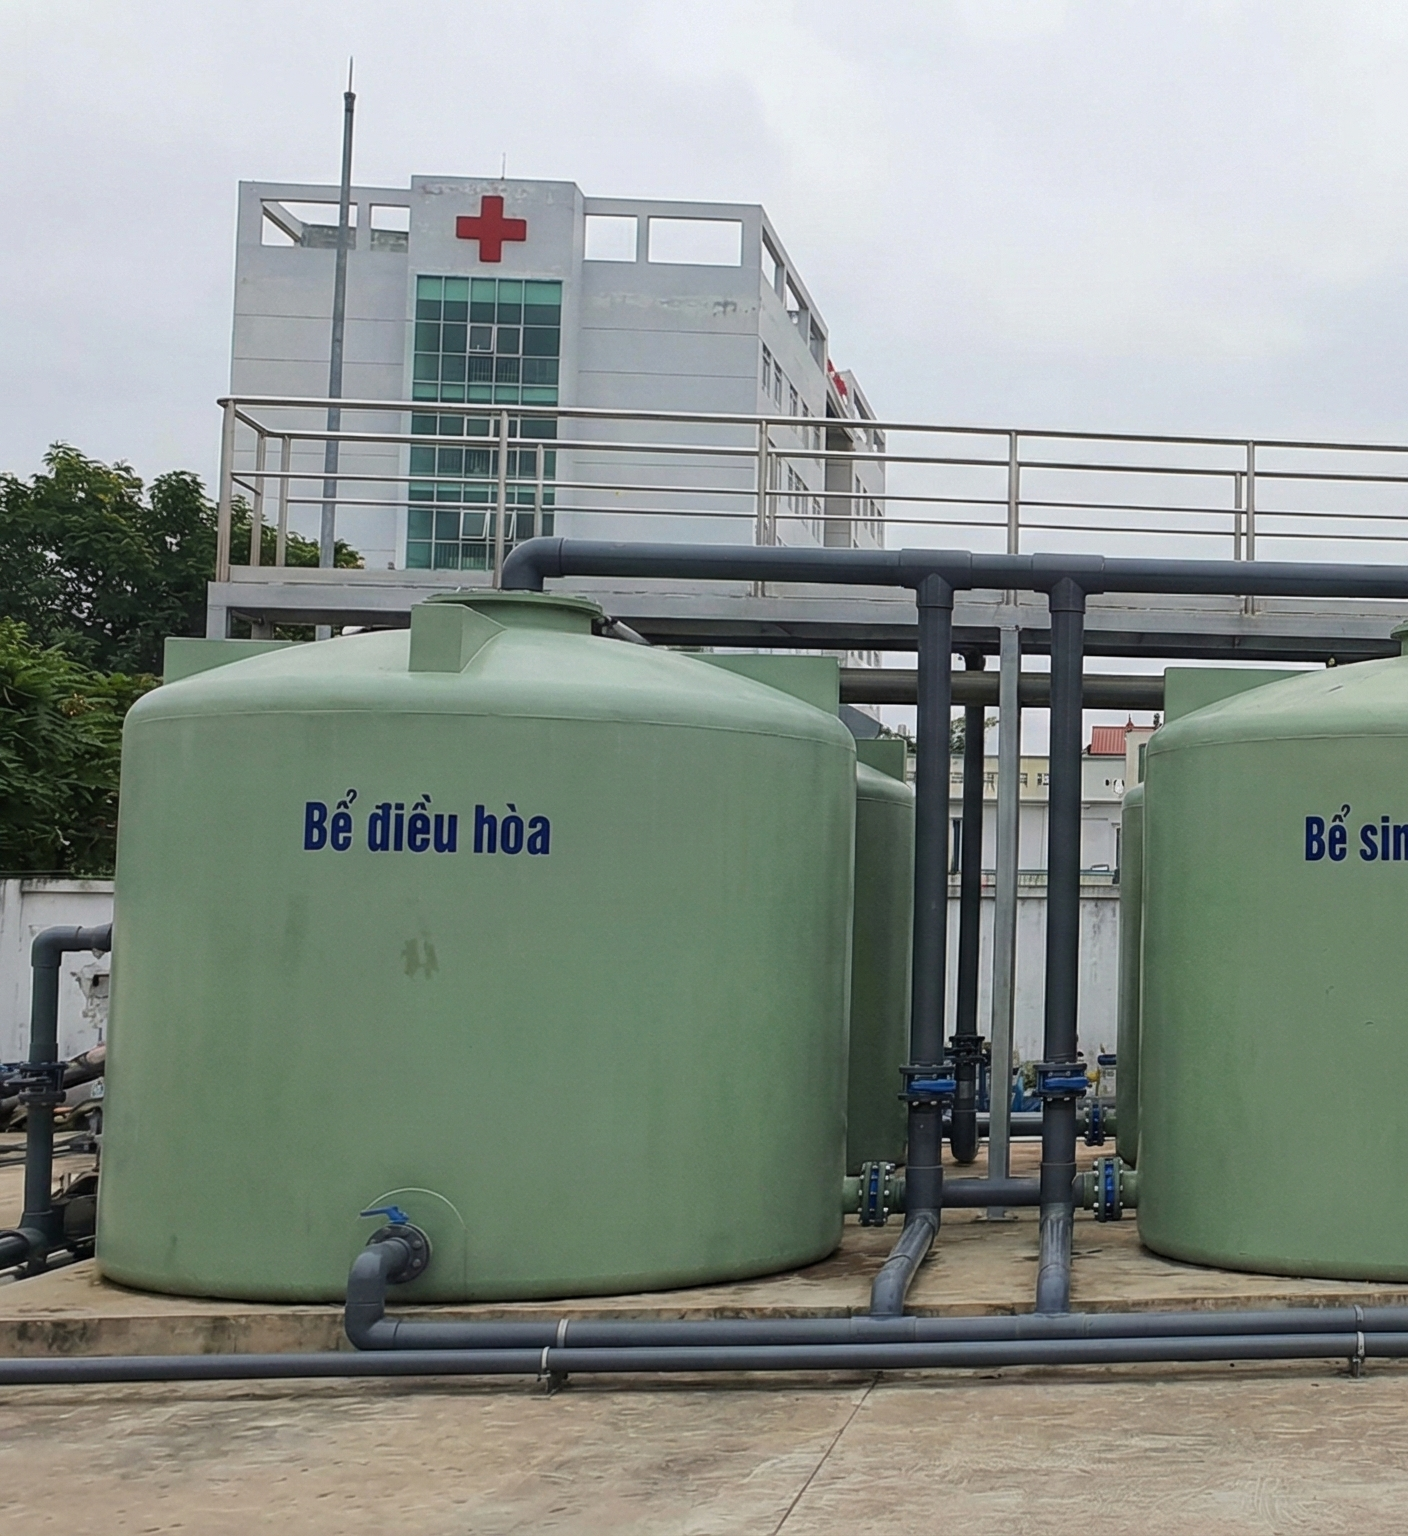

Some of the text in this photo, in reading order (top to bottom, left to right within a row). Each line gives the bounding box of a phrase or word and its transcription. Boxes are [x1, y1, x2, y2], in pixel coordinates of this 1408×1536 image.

[304, 789, 551, 855] Bể điều hòa
[1305, 804, 1350, 861] Bể
